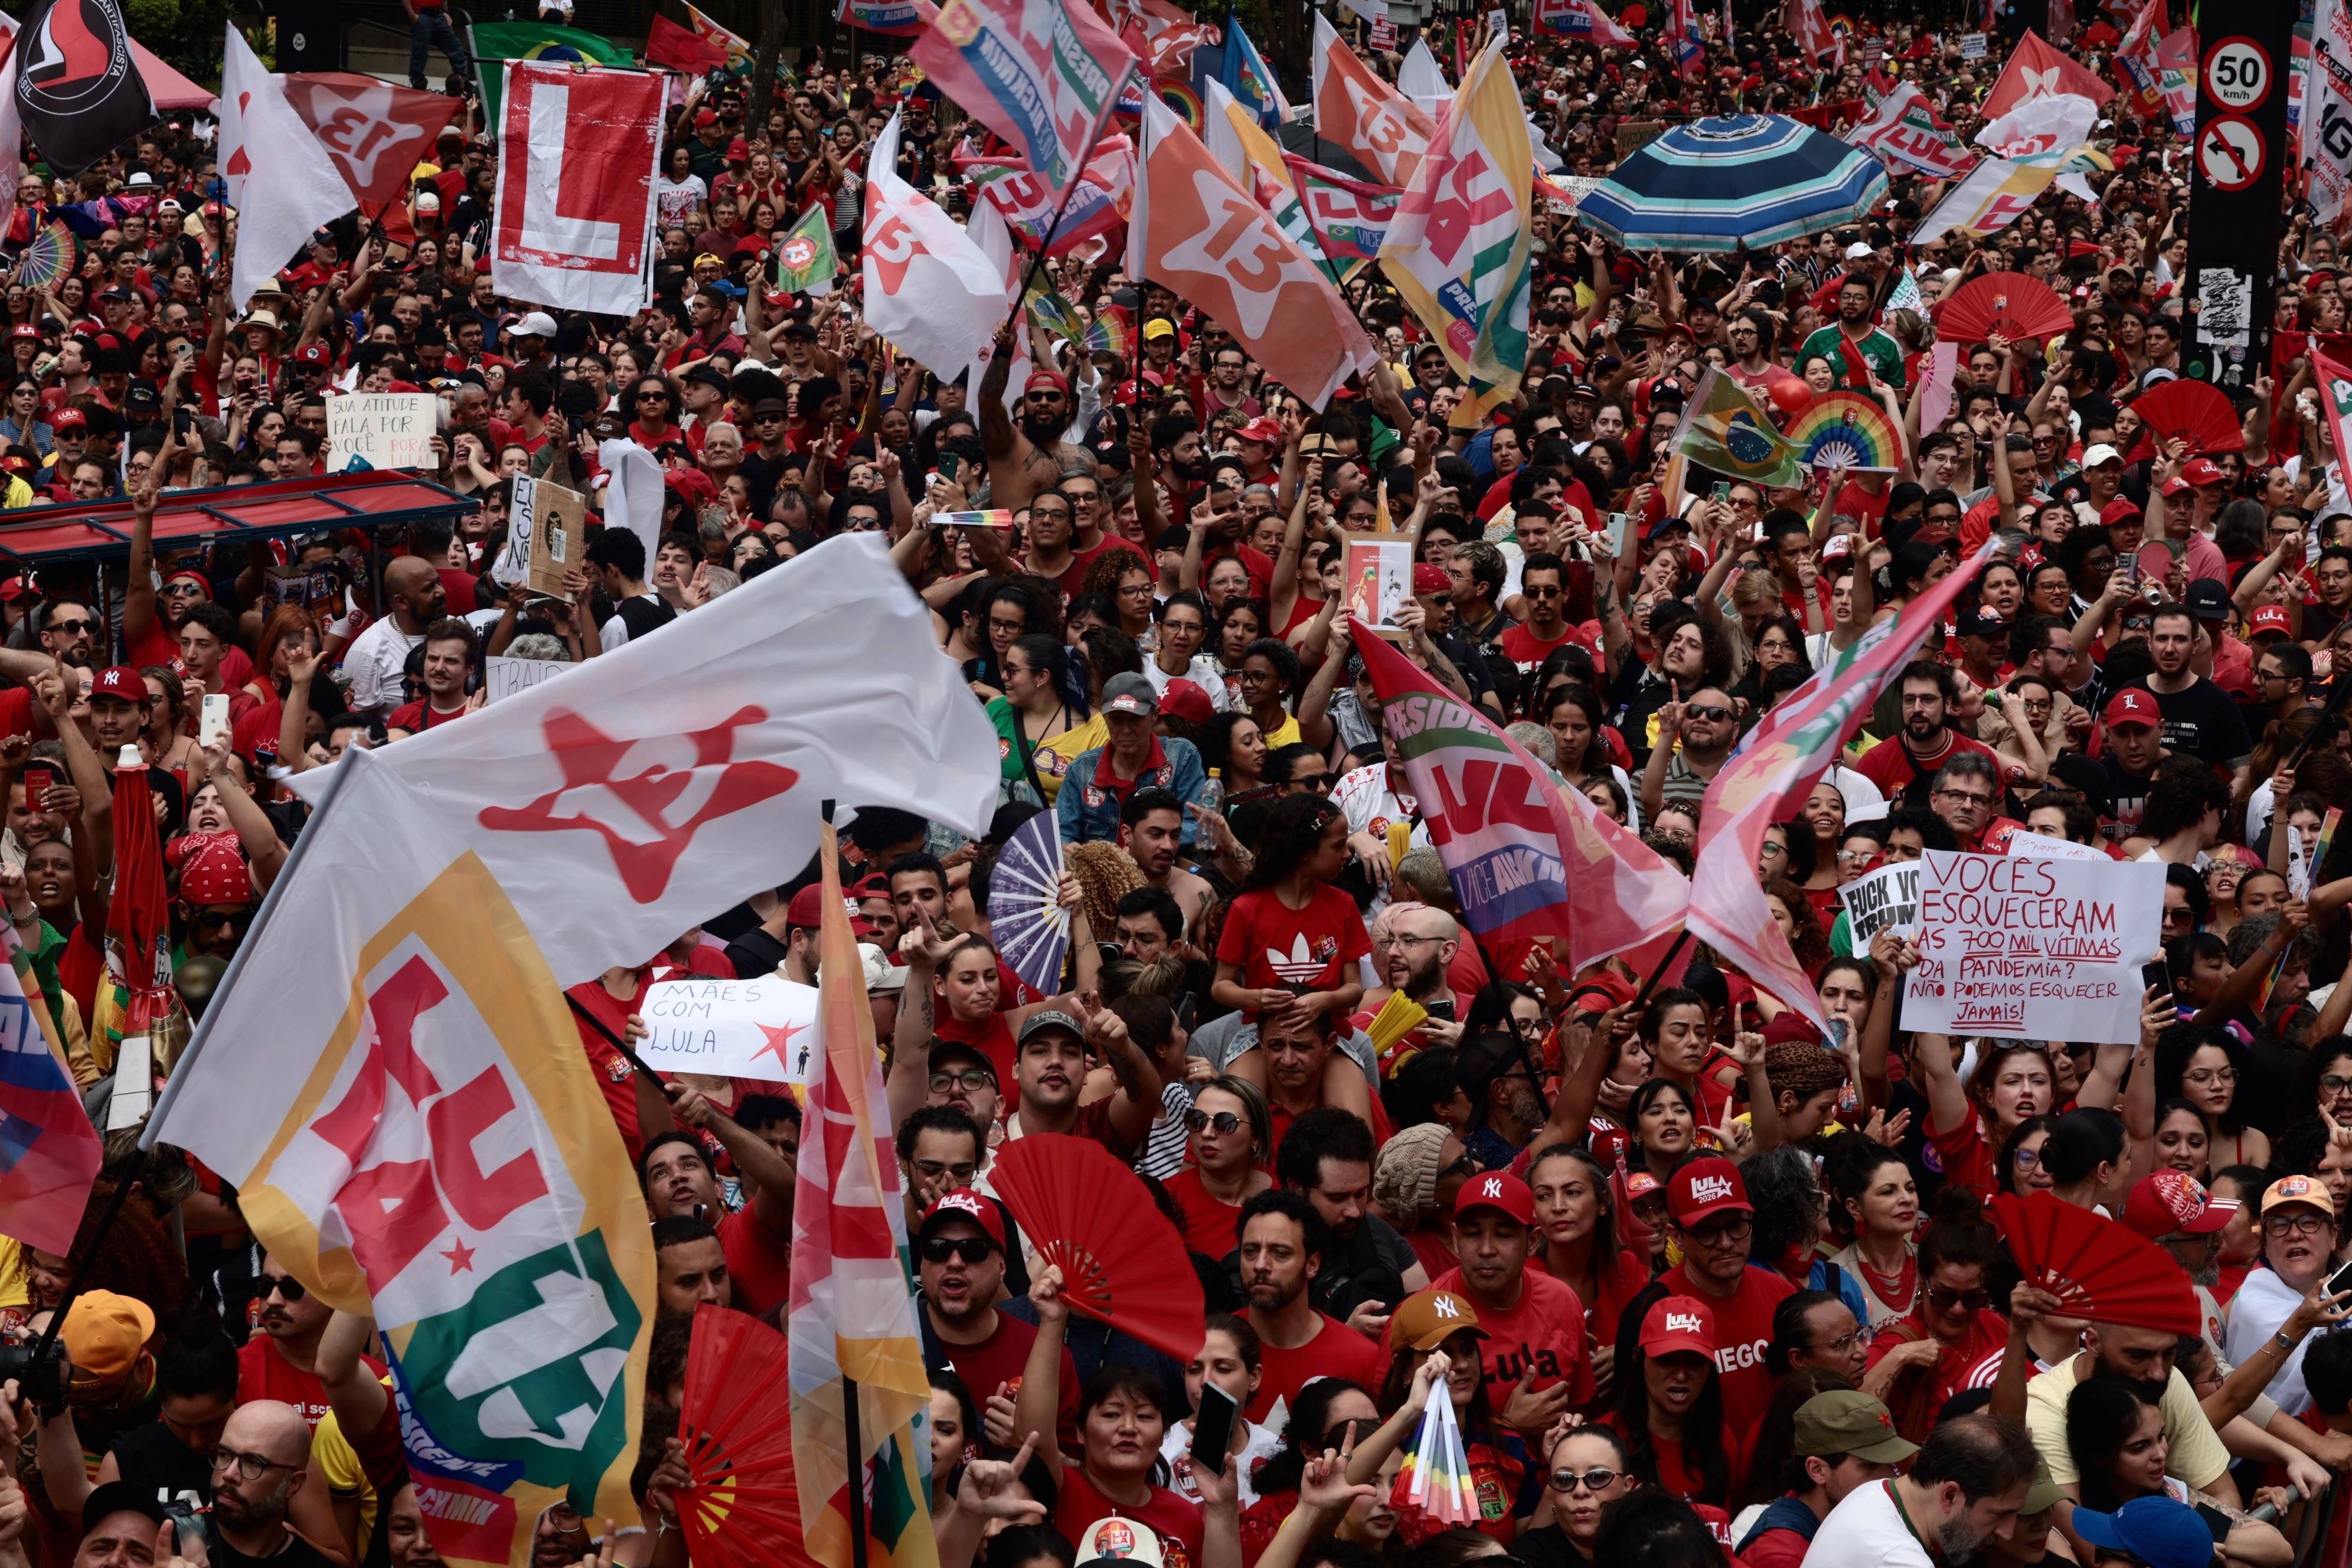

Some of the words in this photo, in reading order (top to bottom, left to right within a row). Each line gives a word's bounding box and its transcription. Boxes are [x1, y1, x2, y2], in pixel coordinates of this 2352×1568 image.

[1572, 15, 1592, 27] ALC
[99, 0, 125, 77] ANTIFASCISTA
[2216, 56, 2260, 87] 50
[2223, 89, 2250, 100] km/h
[1361, 97, 1406, 153] 13
[791, 241, 811, 264] 13
[1204, 198, 1298, 294] 13
[58, 411, 79, 421] LULA
[335, 399, 355, 413] SUA
[362, 398, 419, 412] ATITUDE
[334, 417, 370, 435] FALA
[381, 416, 413, 433] POR
[391, 439, 426, 452] BORA
[390, 453, 430, 467] LULA!
[2025, 549, 2038, 562] 13
[2257, 609, 2284, 622] LULA
[103, 670, 120, 685] NY
[2122, 694, 2139, 709] L
[1383, 697, 1500, 741] RESIDE
[1087, 795, 1100, 805] 13
[1926, 852, 2056, 897] VOCÊS
[1845, 874, 1891, 922] FUCK
[1923, 890, 2115, 935] ESQUECERAM
[1917, 926, 1945, 950] AS
[1958, 930, 2005, 951] 700
[2008, 930, 2040, 952] MIL
[2044, 931, 2121, 957] VÍTIMAS
[1919, 959, 1945, 978] DA
[662, 981, 762, 1002] MÃES
[1910, 979, 1945, 999] NÃO
[1954, 981, 2026, 999] PODEMOS
[2029, 982, 2121, 1001] ESQUECER
[652, 1000, 711, 1018] COM
[1033, 1010, 1076, 1026] TOKYO
[650, 1025, 716, 1054] LULA
[1482, 1177, 1502, 1198] NY
[1690, 1174, 1733, 1200] LULA
[937, 1193, 984, 1217] LULA
[1698, 1193, 1717, 1204] 2026
[1433, 1294, 1459, 1318] NY
[1665, 1312, 1703, 1333] LULA
[1492, 1506, 1502, 1514] 13
